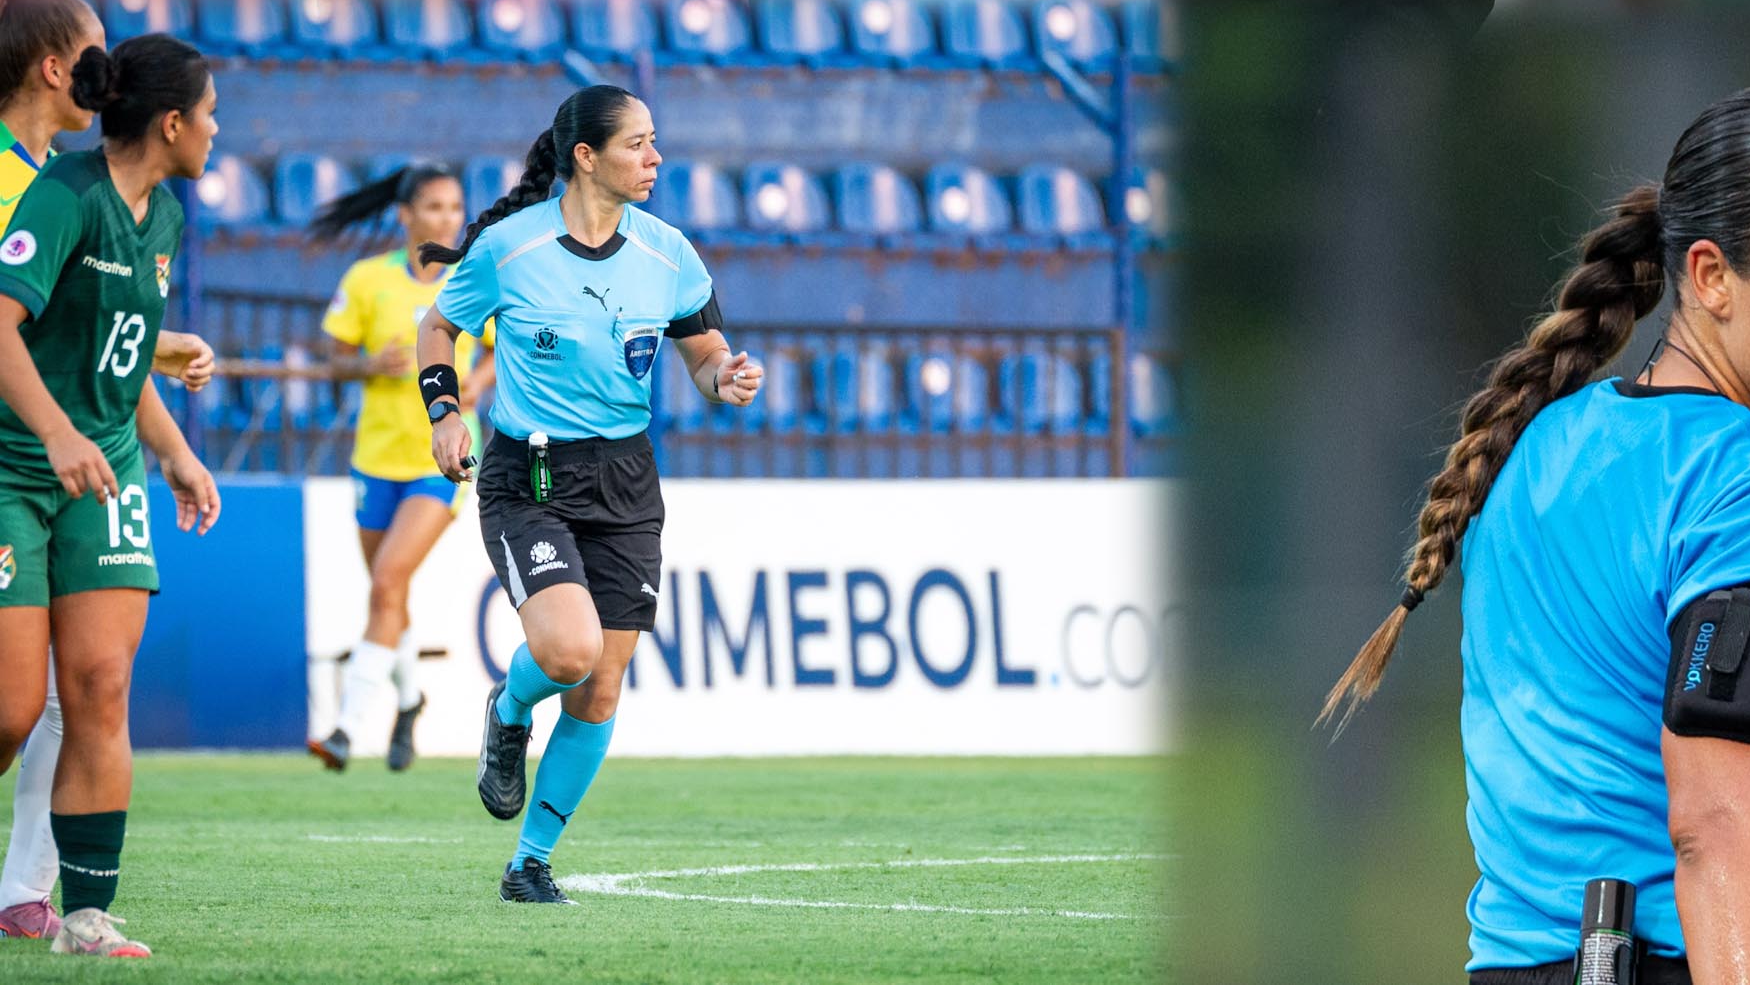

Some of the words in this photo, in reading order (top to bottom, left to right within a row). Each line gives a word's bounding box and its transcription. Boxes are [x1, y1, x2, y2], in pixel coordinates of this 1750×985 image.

[97, 310, 146, 378] 13
[103, 484, 150, 549] 13
[1683, 622, 1715, 691] VOKKERO
